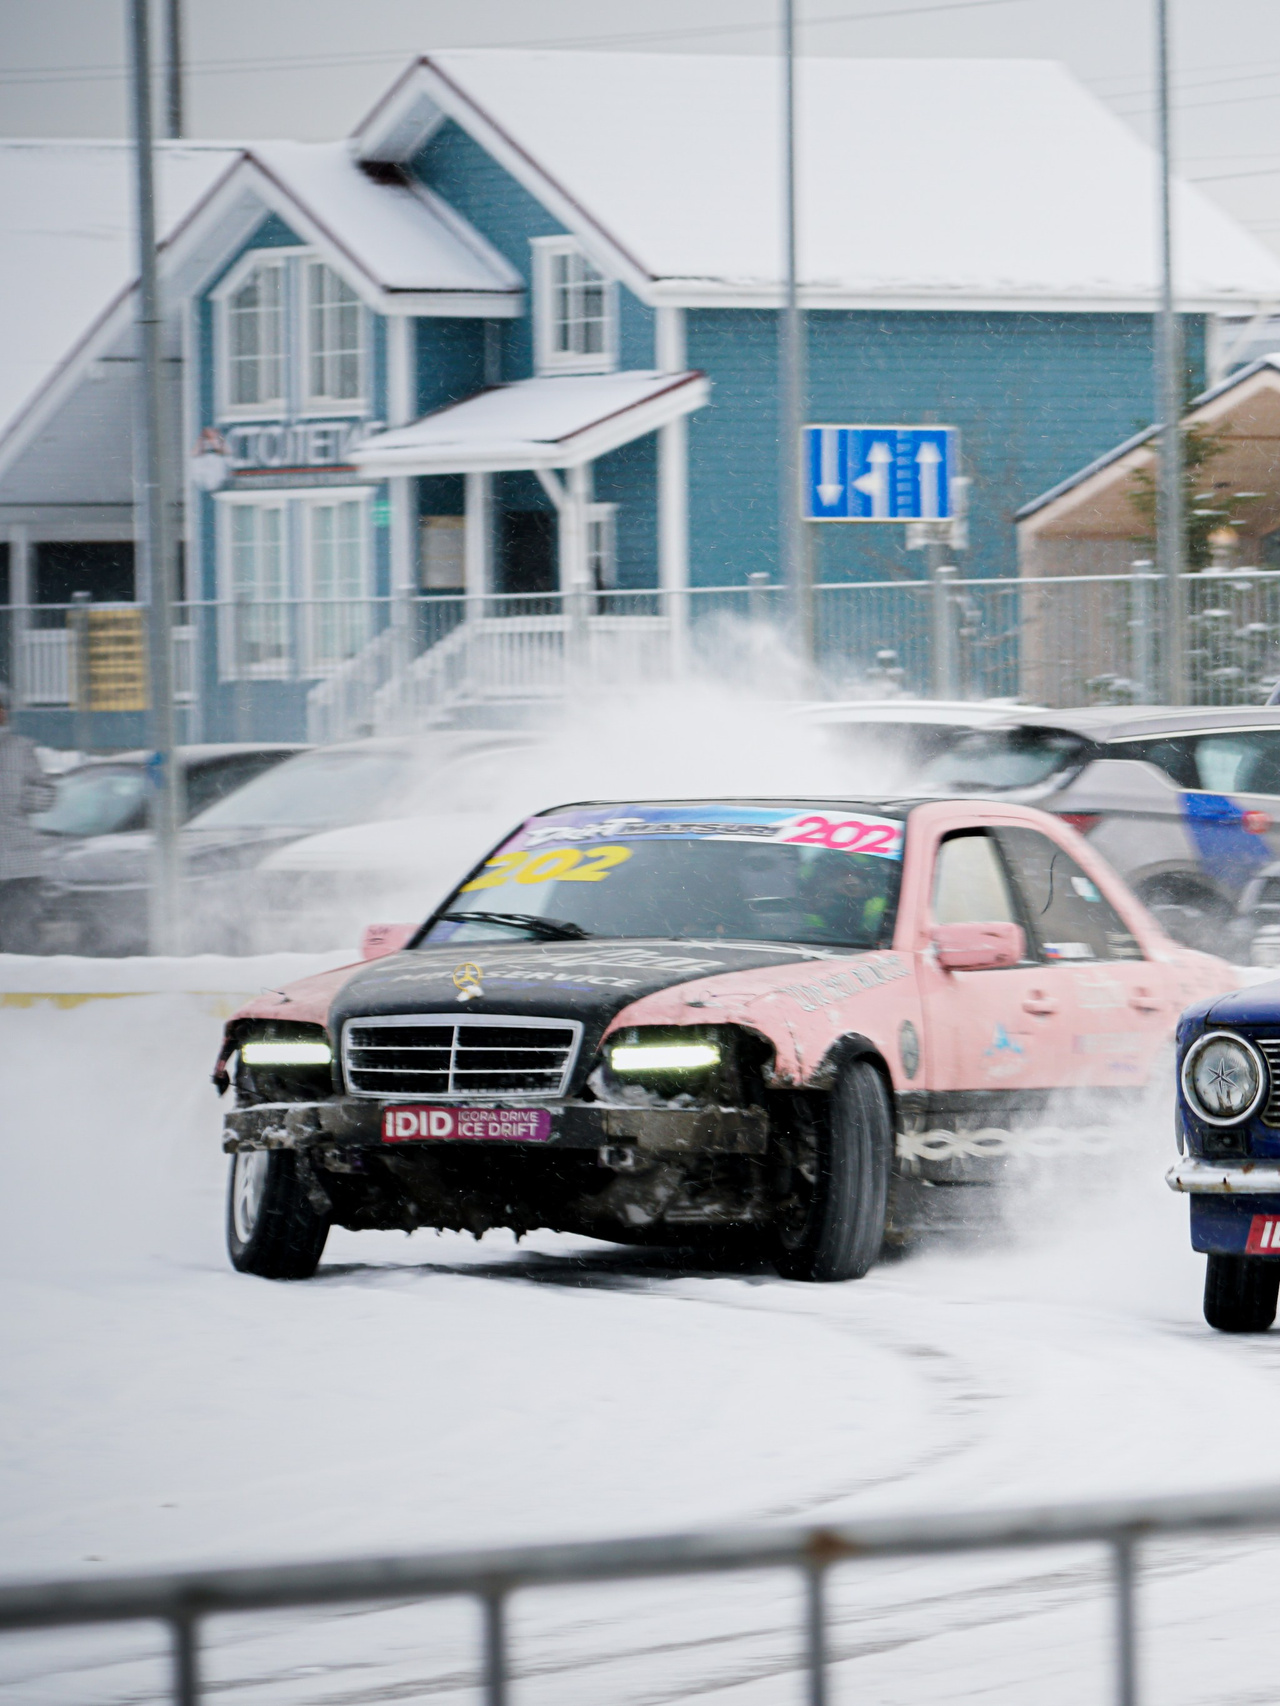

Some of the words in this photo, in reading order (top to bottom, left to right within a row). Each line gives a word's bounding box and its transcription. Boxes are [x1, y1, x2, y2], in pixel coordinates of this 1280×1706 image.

[615, 821, 784, 838] MATSURI
[783, 816, 898, 854] 202
[459, 846, 634, 893] 202
[482, 970, 643, 988] SERVICE
[385, 1110, 454, 1138] IDID
[457, 1110, 497, 1121] IGORA
[499, 1111, 540, 1122] DRIVE
[457, 1122, 485, 1137] ICE
[487, 1122, 540, 1137] DRIFT
